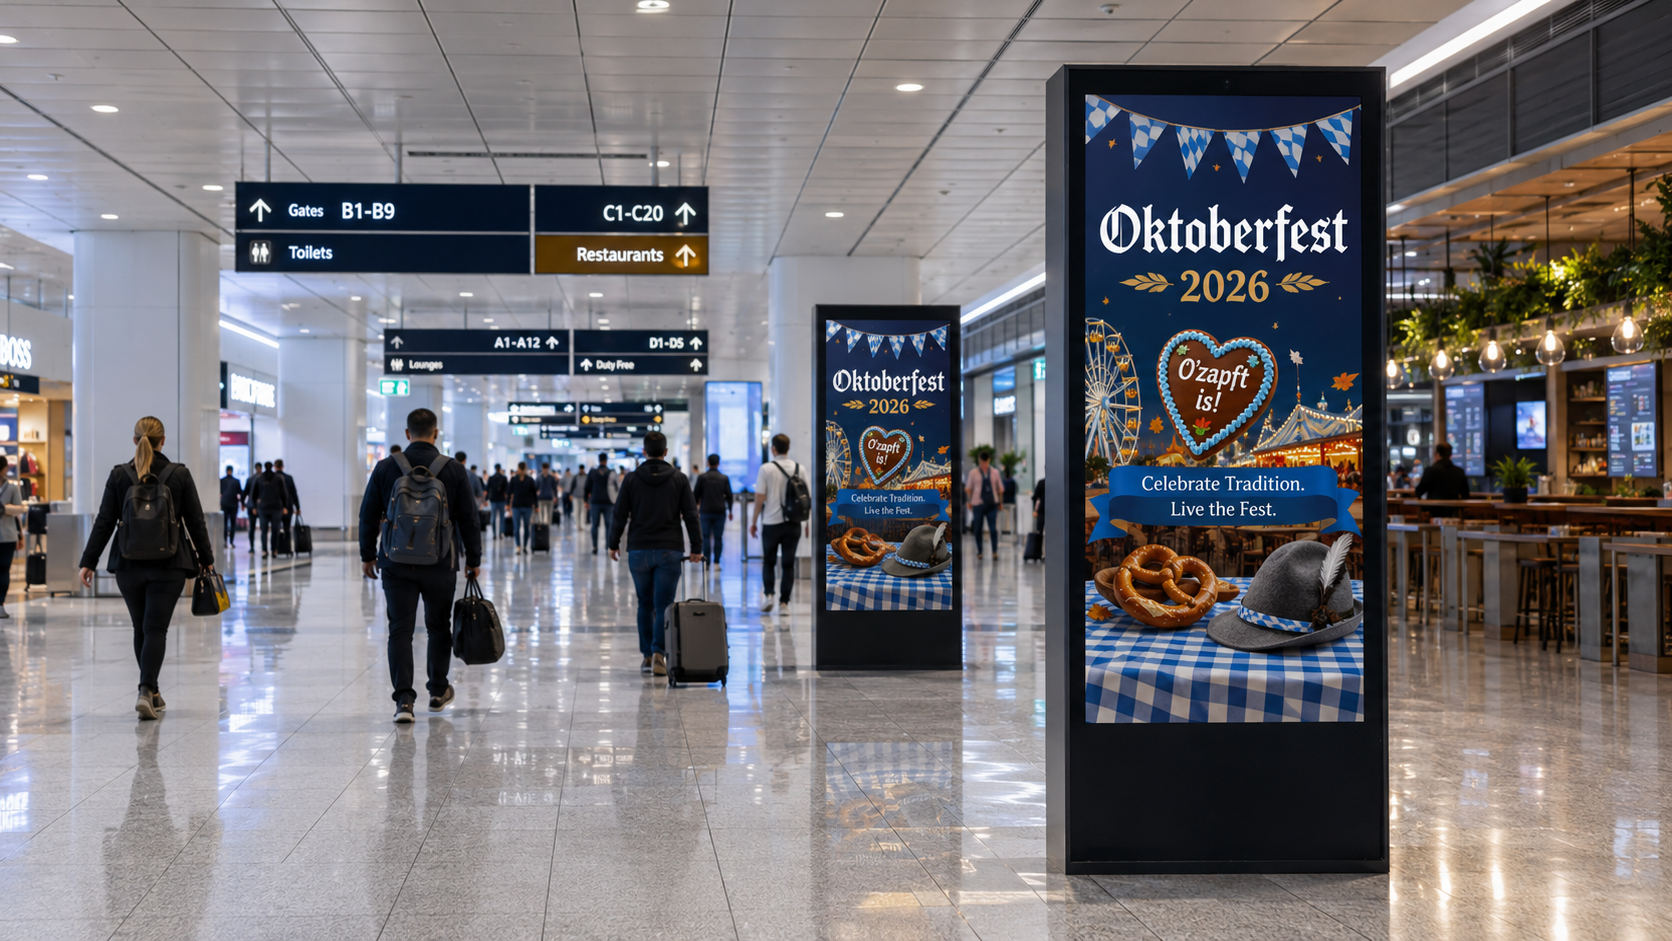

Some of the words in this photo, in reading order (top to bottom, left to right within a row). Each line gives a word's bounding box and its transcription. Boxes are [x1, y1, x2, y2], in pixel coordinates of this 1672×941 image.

[289, 204, 323, 217] Gates
[342, 203, 394, 219] B1-B9
[604, 205, 663, 221] C1-C20
[1100, 204, 1348, 262] Oktoberfest
[289, 246, 332, 259] Toilets
[578, 247, 663, 262] Restaurants
[1181, 270, 1269, 302] 2026
[494, 337, 541, 349] A1-A12
[408, 360, 444, 372] Lounges
[595, 360, 616, 372] Duty
[616, 360, 635, 370] Free
[833, 369, 944, 396] Oktoberfest
[869, 399, 909, 414] 2026
[1195, 388, 1222, 413] is!
[876, 453, 888, 465] is!
[1142, 476, 1219, 491] Celebrate
[1225, 475, 1304, 491] Tradition.
[851, 494, 888, 503] Celebrate
[864, 507, 881, 515] Live
[881, 506, 894, 515] the
[1172, 502, 1204, 516] Live
[1209, 501, 1234, 516] the
[1240, 502, 1276, 516] Fest.
